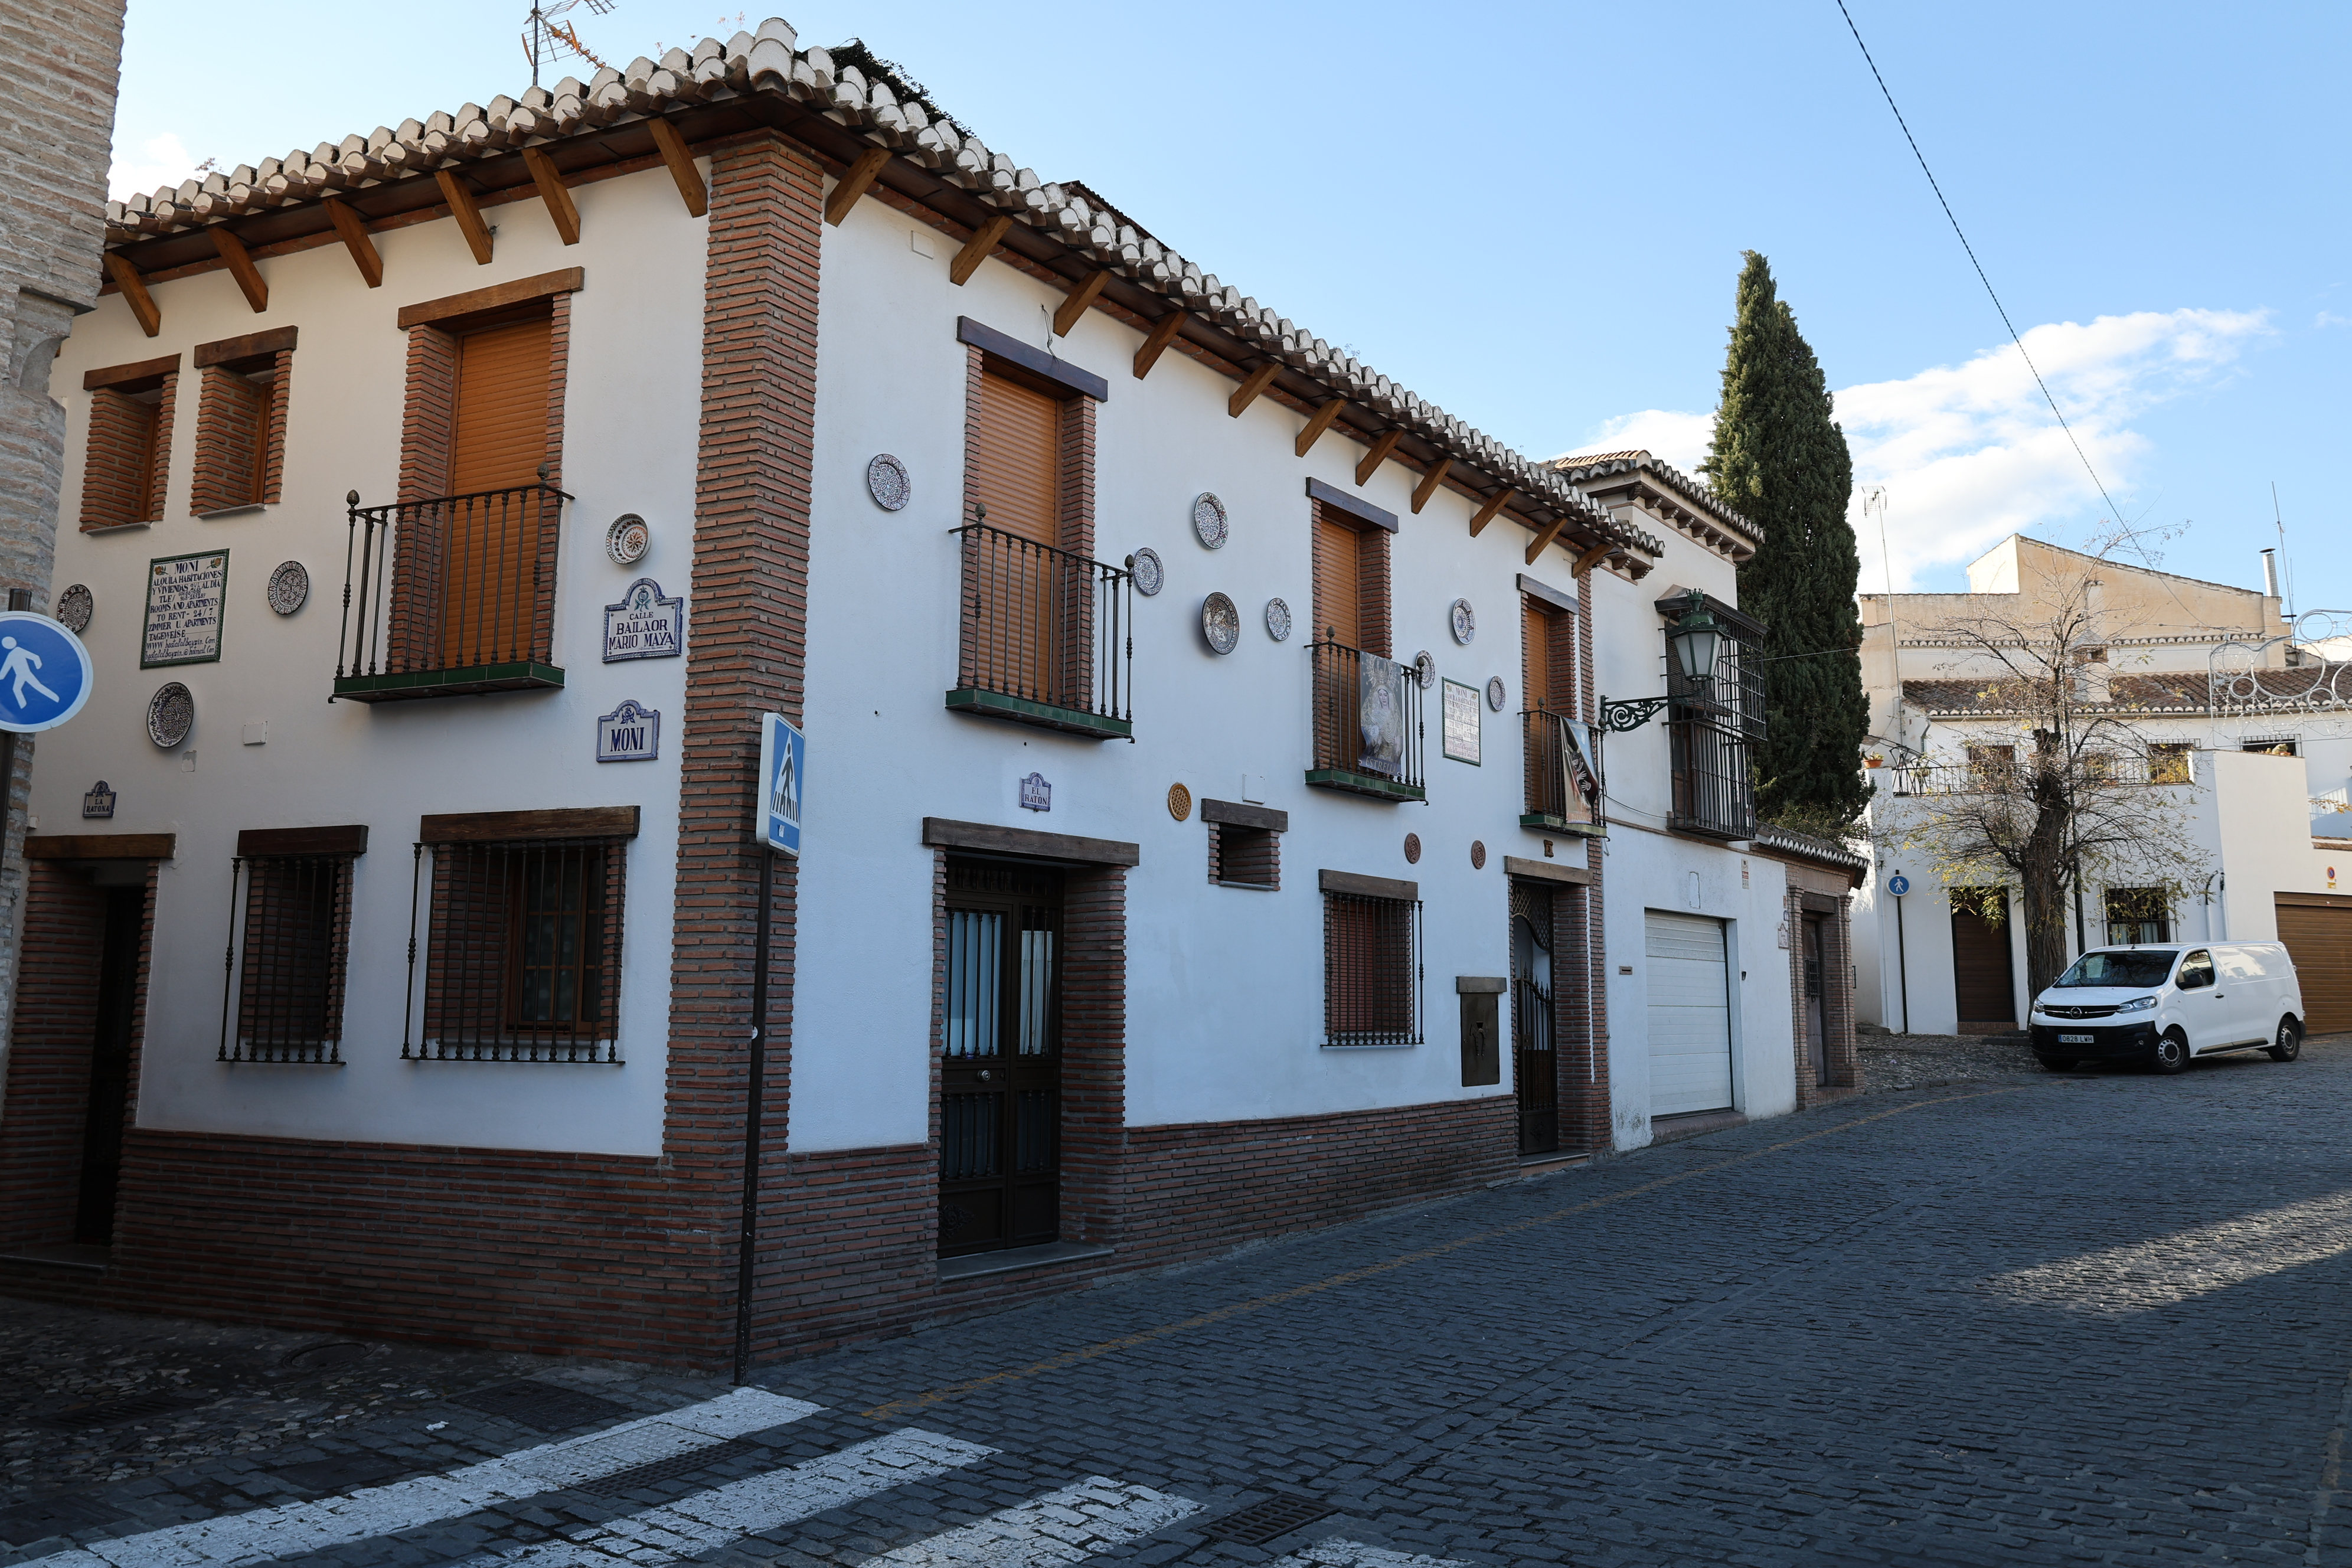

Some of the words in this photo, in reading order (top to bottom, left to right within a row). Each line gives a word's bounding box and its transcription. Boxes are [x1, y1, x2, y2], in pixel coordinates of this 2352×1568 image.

[178, 569, 223, 583] HABITACIONES
[152, 587, 158, 596] Y
[158, 583, 188, 594] VIVIENDAS
[202, 580, 210, 589] AL
[150, 603, 171, 614] ROOMS
[172, 601, 184, 610] AND
[185, 597, 218, 609] APARTMENTS
[148, 621, 171, 632] ZIMMER
[183, 616, 217, 628] APARTMENTS
[157, 614, 165, 622] TO
[629, 612, 654, 620] CALLE
[616, 619, 668, 635] BAILAOR
[148, 629, 186, 642] TAGEWEISE
[609, 635, 638, 650] MARIO
[643, 632, 675, 647] MAYA
[610, 727, 645, 752] MONI
[1366, 756, 1396, 773] ESTRELLA
[1031, 787, 1041, 795] EL
[1024, 794, 1047, 805] RATON
